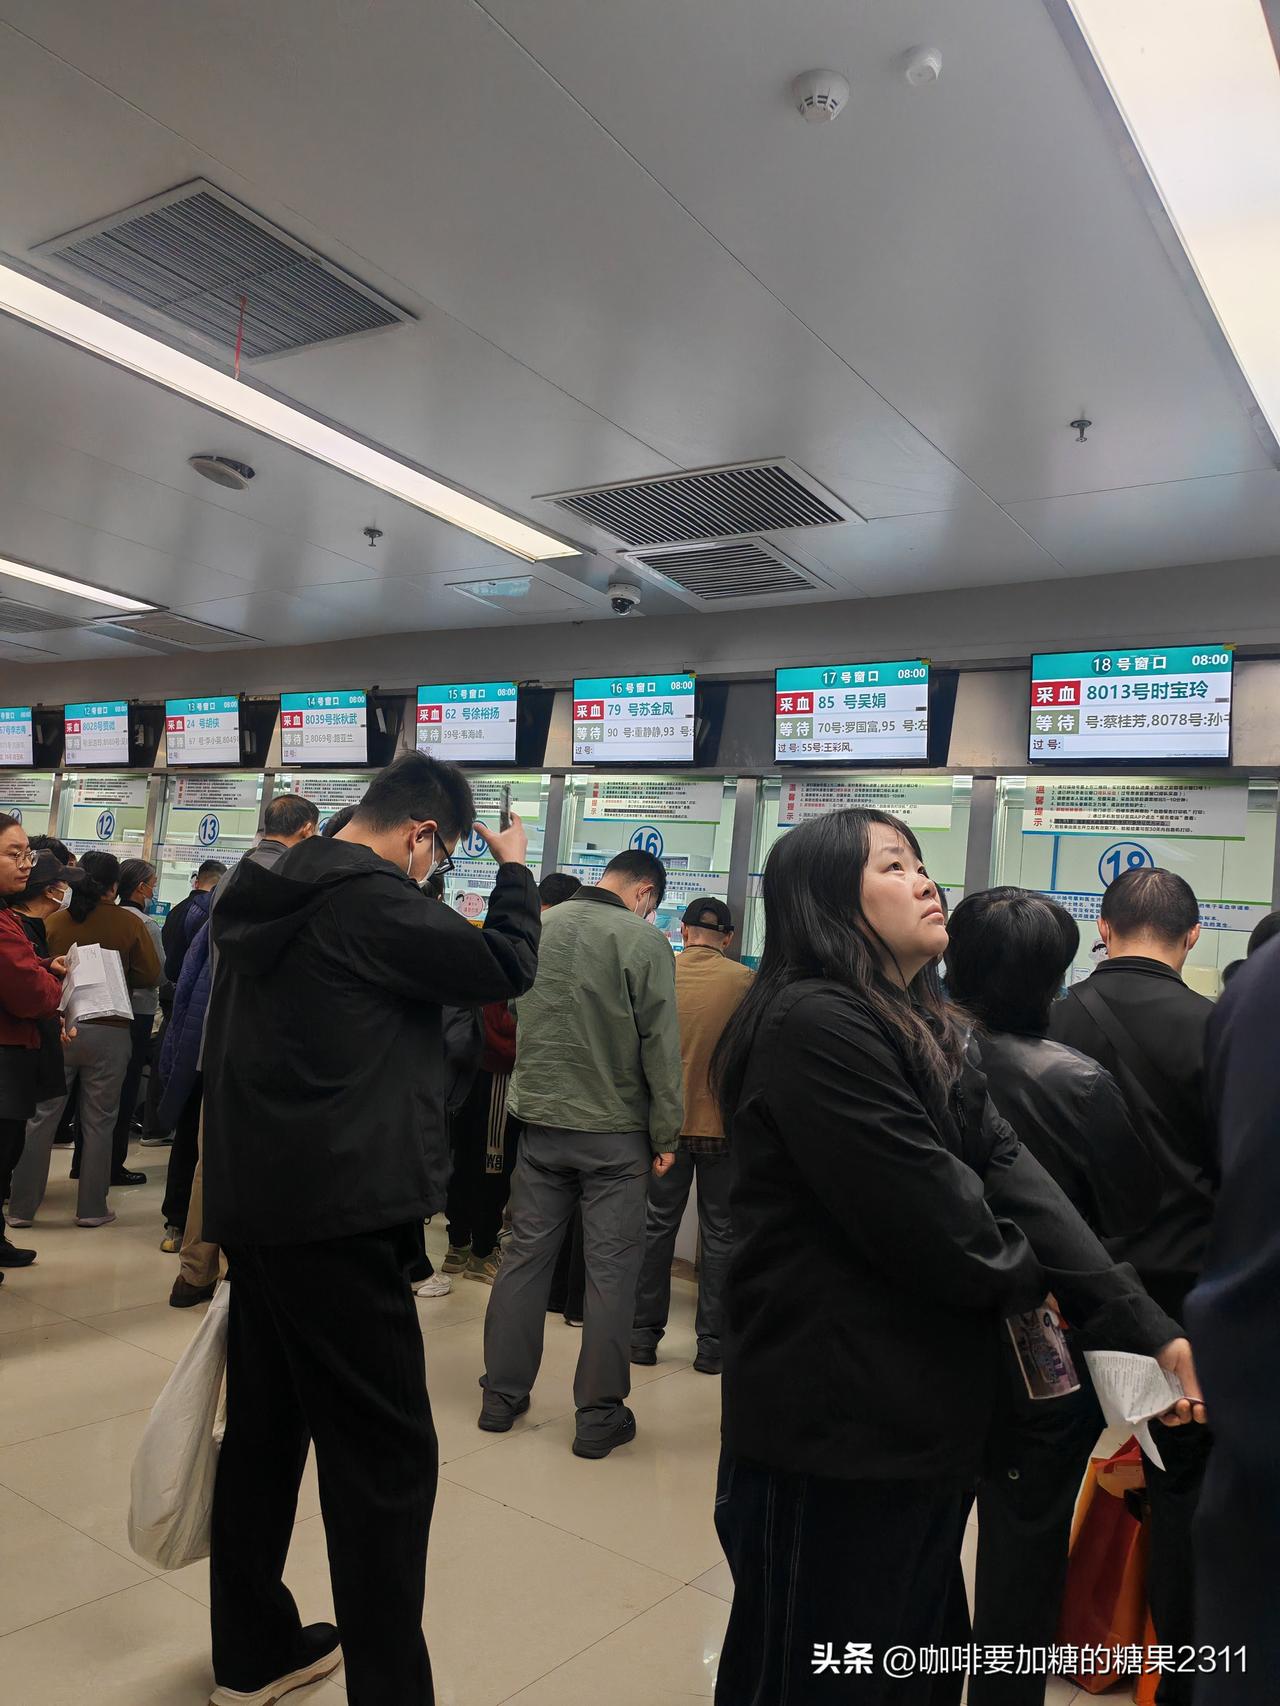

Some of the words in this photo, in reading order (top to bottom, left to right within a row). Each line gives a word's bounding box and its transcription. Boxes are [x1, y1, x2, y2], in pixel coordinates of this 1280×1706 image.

[1093, 658, 1112, 672] 18
[1116, 655, 1168, 671] 号窗口
[1191, 653, 1229, 666] 08:00
[822, 672, 836, 684] 17
[840, 670, 879, 684] 号窗口
[897, 668, 926, 679] 08:00
[448, 689, 457, 699] 15
[497, 688, 516, 696] 08:00
[610, 683, 622, 693] 16
[625, 682, 656, 693] 号窗口
[670, 680, 693, 690] 08:00
[1036, 685, 1076, 704] 采血
[1086, 680, 1209, 701] 8013号时宝玲
[307, 697, 316, 706] 14
[576, 704, 601, 718] 采血
[607, 704, 622, 716] 79
[628, 702, 674, 717] 号苏金凤
[779, 697, 810, 712] 采血
[818, 696, 835, 709] 85
[843, 693, 886, 710] 号吴娟
[419, 708, 440, 720] 采血
[445, 708, 456, 719] 62
[779, 722, 810, 737] 等待
[818, 720, 896, 734] 70号:罗国富,95
[1035, 714, 1075, 732] 等待
[607, 728, 618, 738] 90
[99, 815, 112, 836] 12
[201, 818, 217, 840] 13
[633, 832, 659, 859] 16
